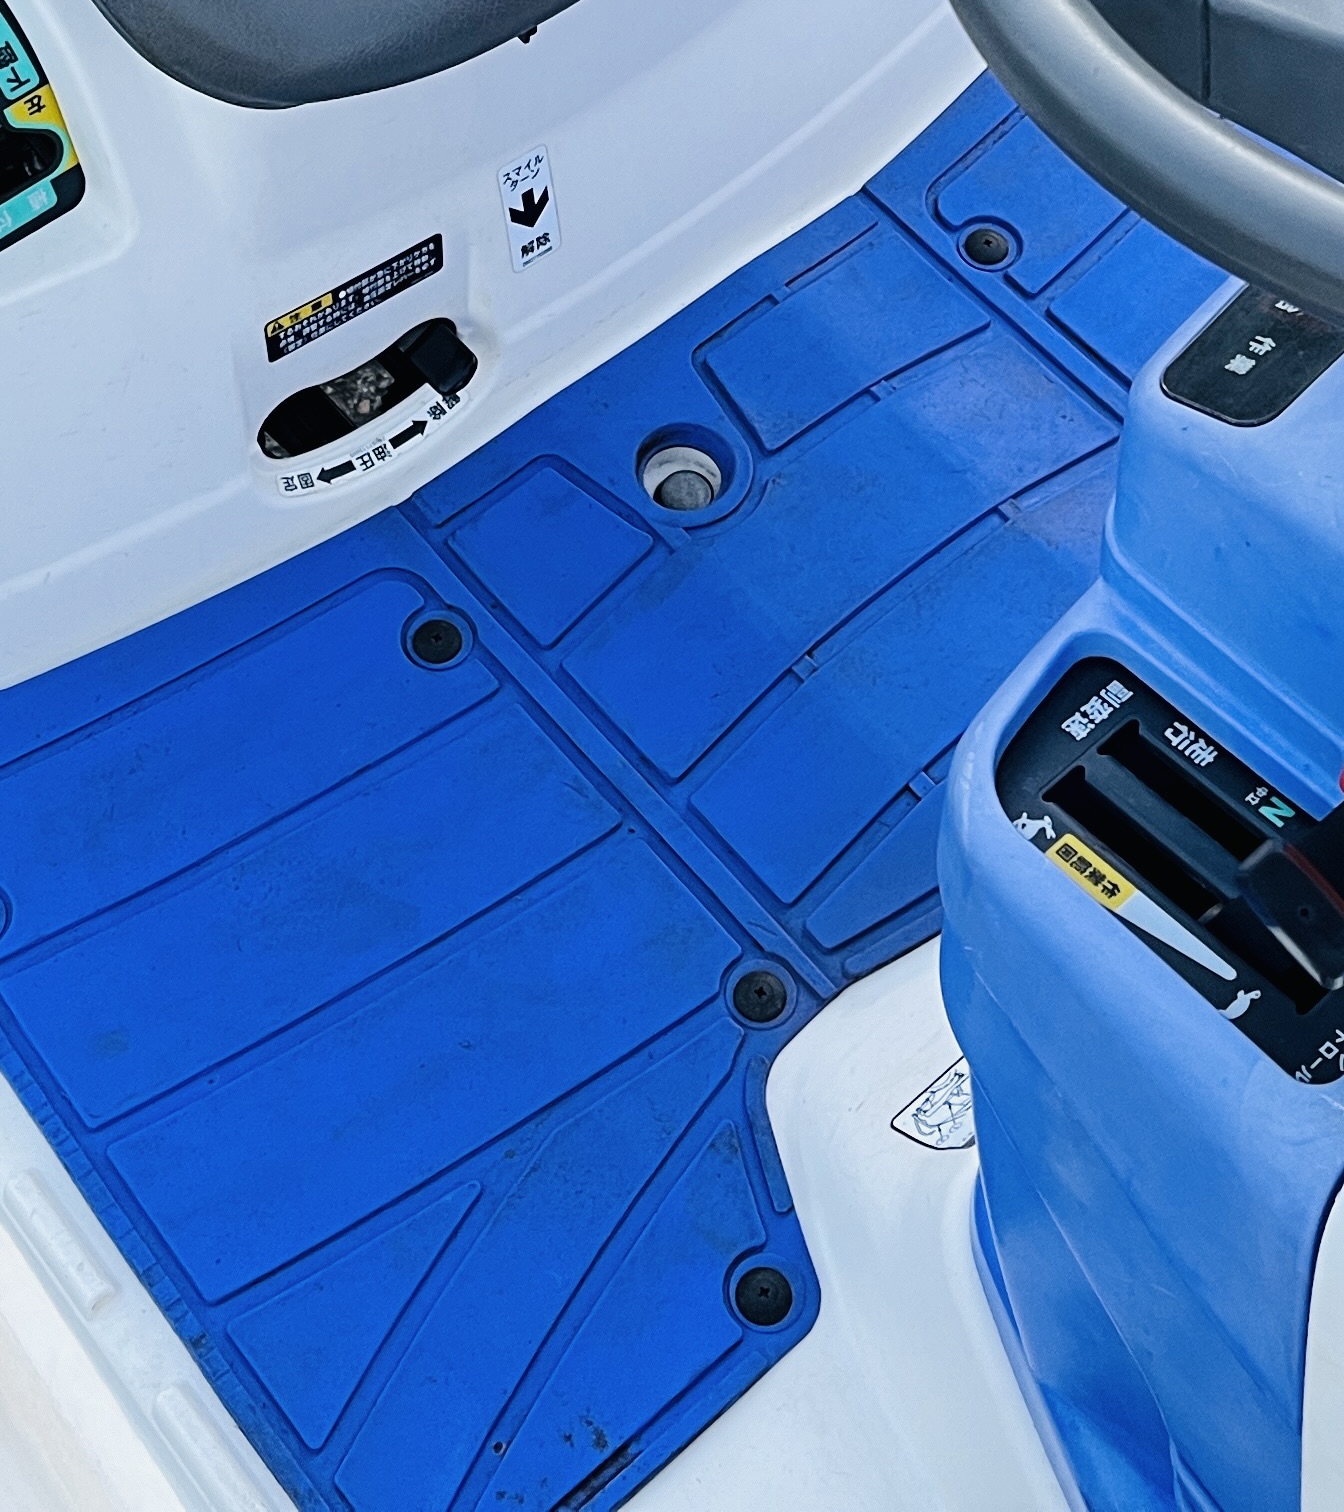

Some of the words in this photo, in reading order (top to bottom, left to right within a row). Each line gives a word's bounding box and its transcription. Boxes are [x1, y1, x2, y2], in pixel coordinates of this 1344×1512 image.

[24, 94, 47, 114] 左
[503, 154, 544, 185] スマイル
[509, 169, 541, 191] ターン
[520, 232, 551, 258] 解除
[356, 444, 393, 471] 油圧
[282, 473, 313, 492] 固定
[1061, 680, 1134, 741] 副変速
[1164, 721, 1218, 768] 走行
[1245, 787, 1269, 806] 中立
[1258, 796, 1296, 828] N
[1056, 843, 1122, 900] 作業範囲
